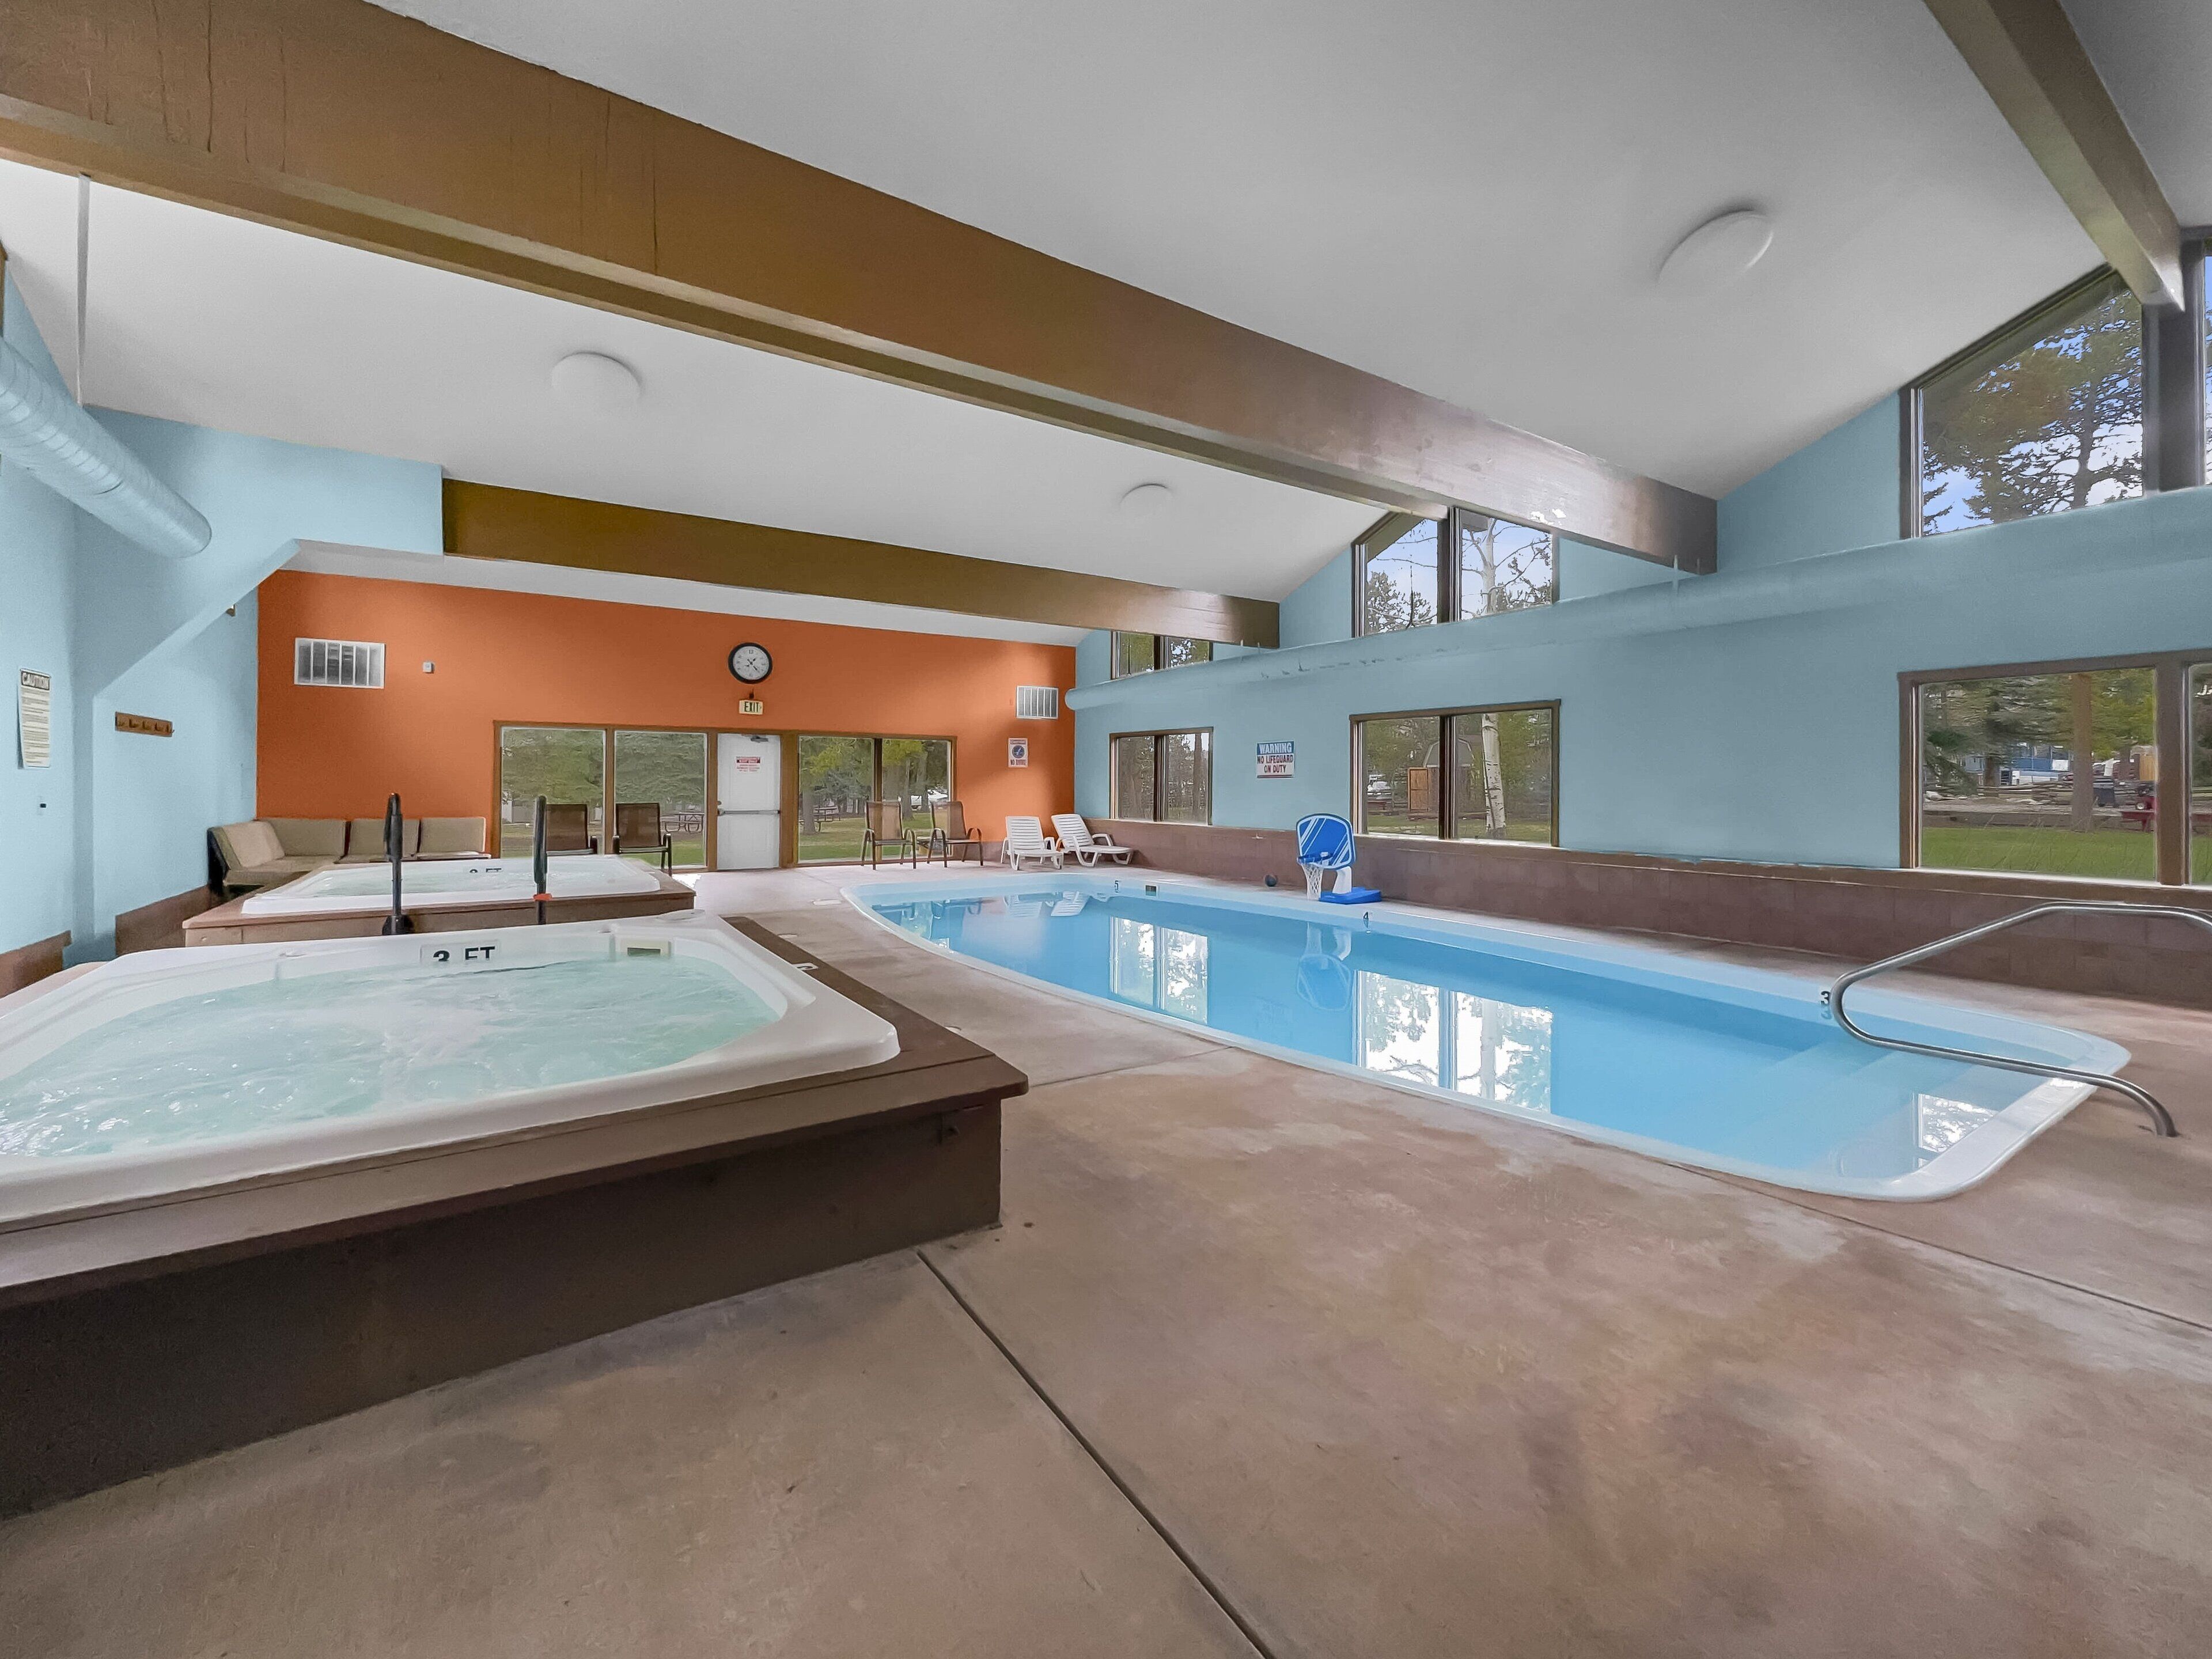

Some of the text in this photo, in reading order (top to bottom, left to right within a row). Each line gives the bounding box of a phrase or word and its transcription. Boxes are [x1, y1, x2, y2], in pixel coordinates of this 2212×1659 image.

[744, 701, 759, 713] EXIT
[1259, 743, 1292, 754] WARNING
[1257, 755, 1294, 764] NO LIFEGUARD
[1264, 764, 1287, 773] ON DUTY
[1363, 911, 1369, 920] 4
[465, 946, 495, 960] FT
[1820, 991, 1831, 1005] 3
